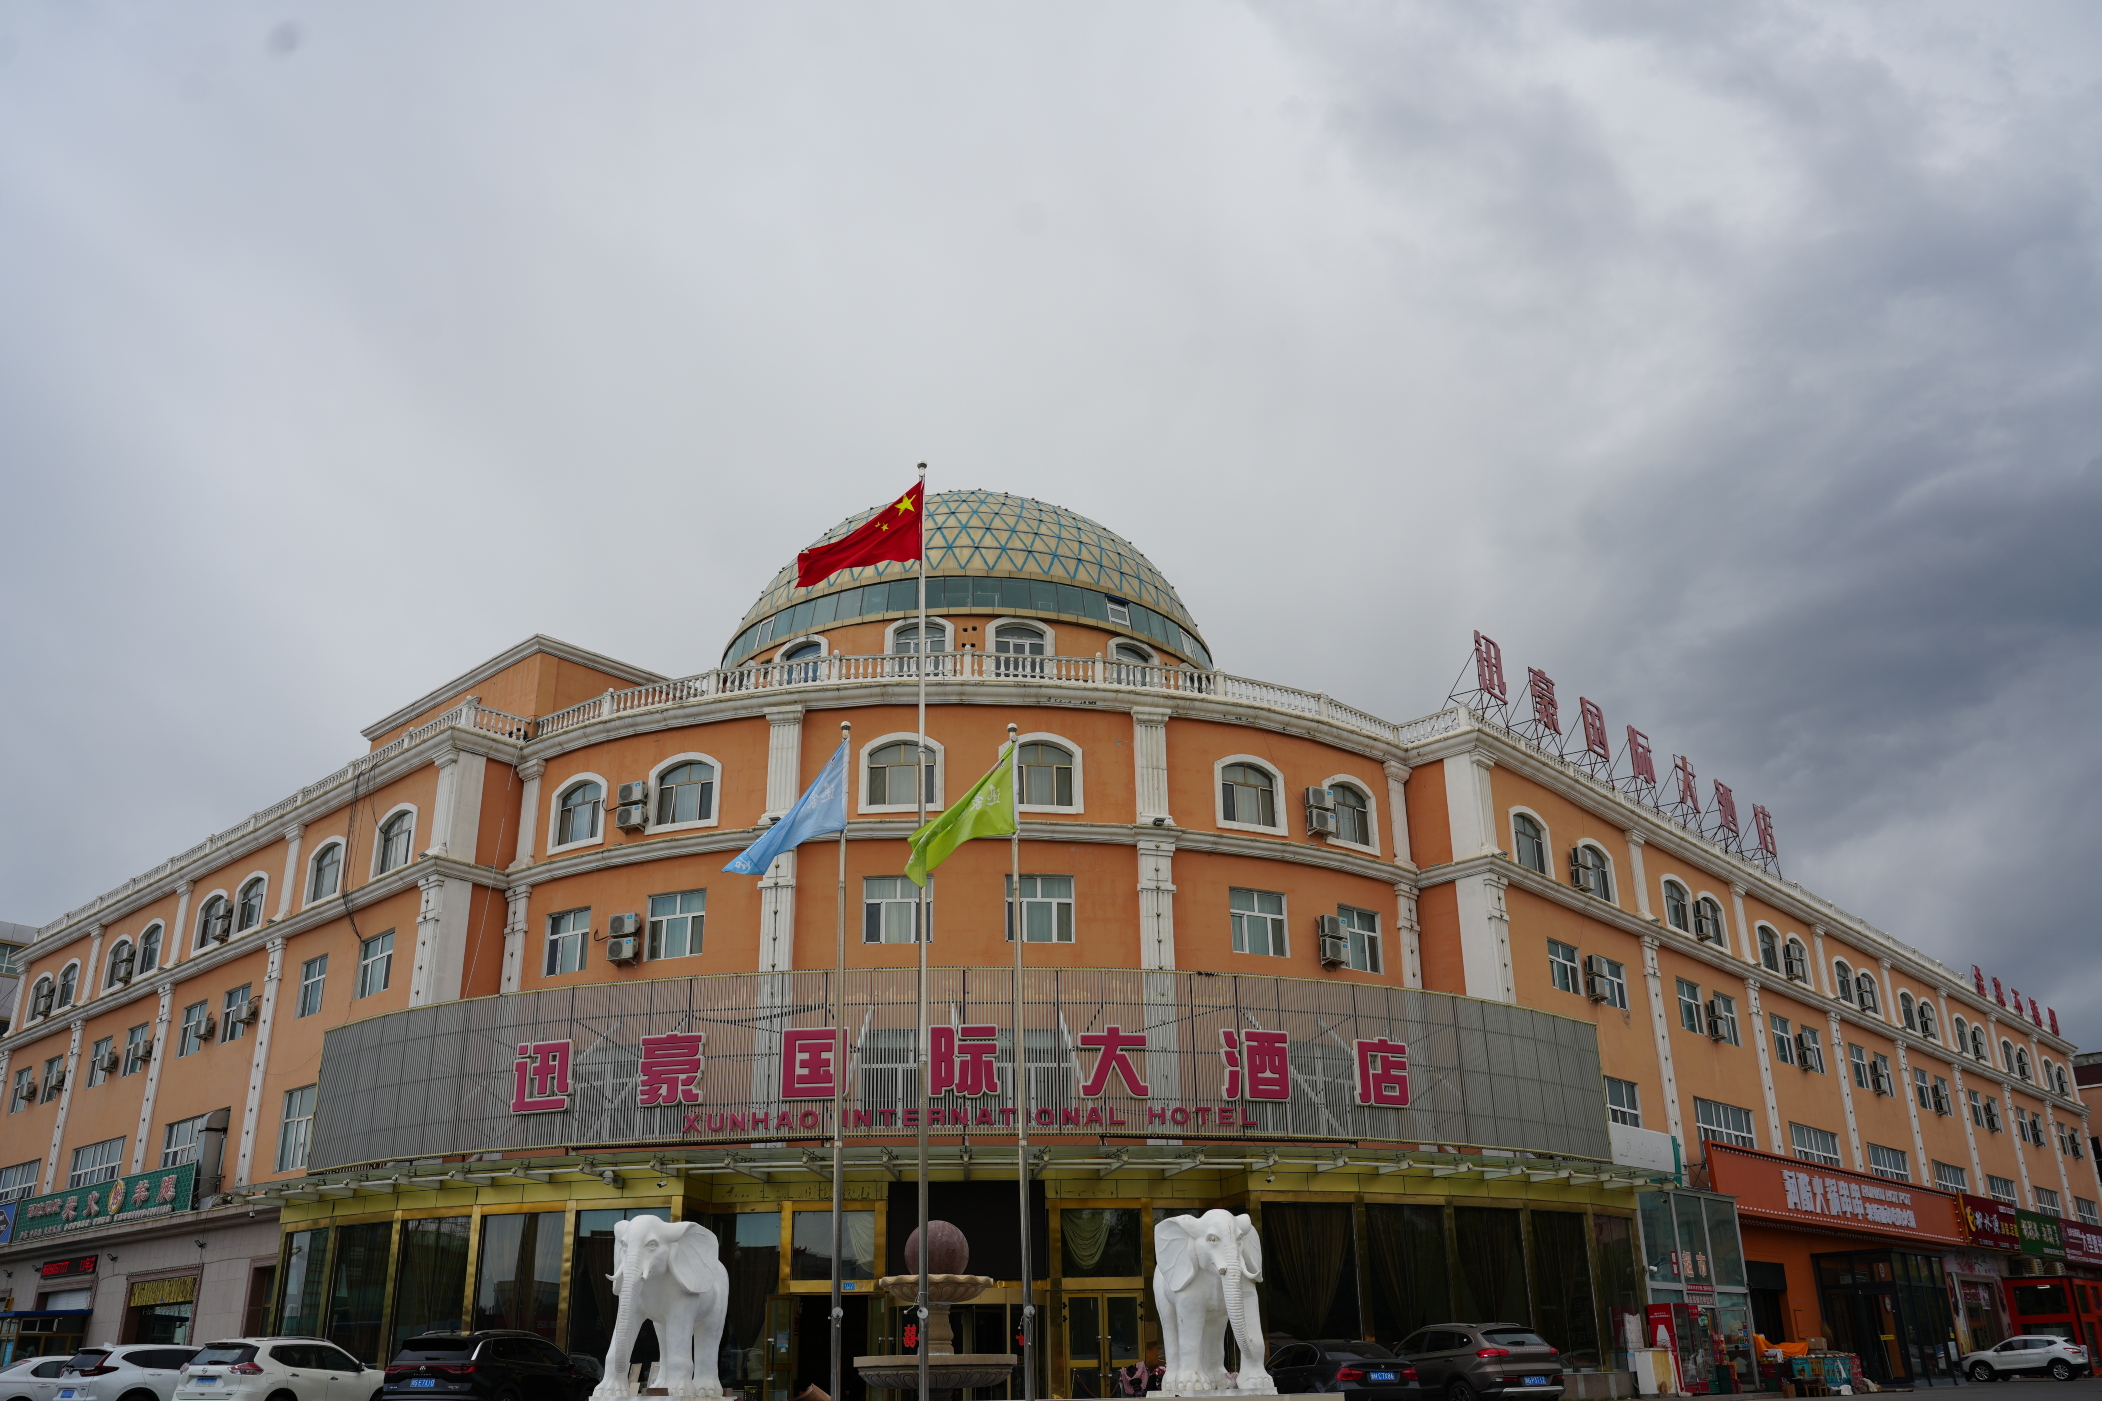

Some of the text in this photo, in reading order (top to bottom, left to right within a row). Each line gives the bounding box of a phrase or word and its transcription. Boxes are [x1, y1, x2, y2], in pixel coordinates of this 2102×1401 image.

[1473, 629, 1778, 857] 迅豪国际大酒店
[510, 1023, 1411, 1115] 迅豪国际大酒店
[682, 1110, 819, 1133] XUNHAO
[1148, 1106, 1258, 1127] HOTEL
[1682, 1250, 1708, 1278] 超市
